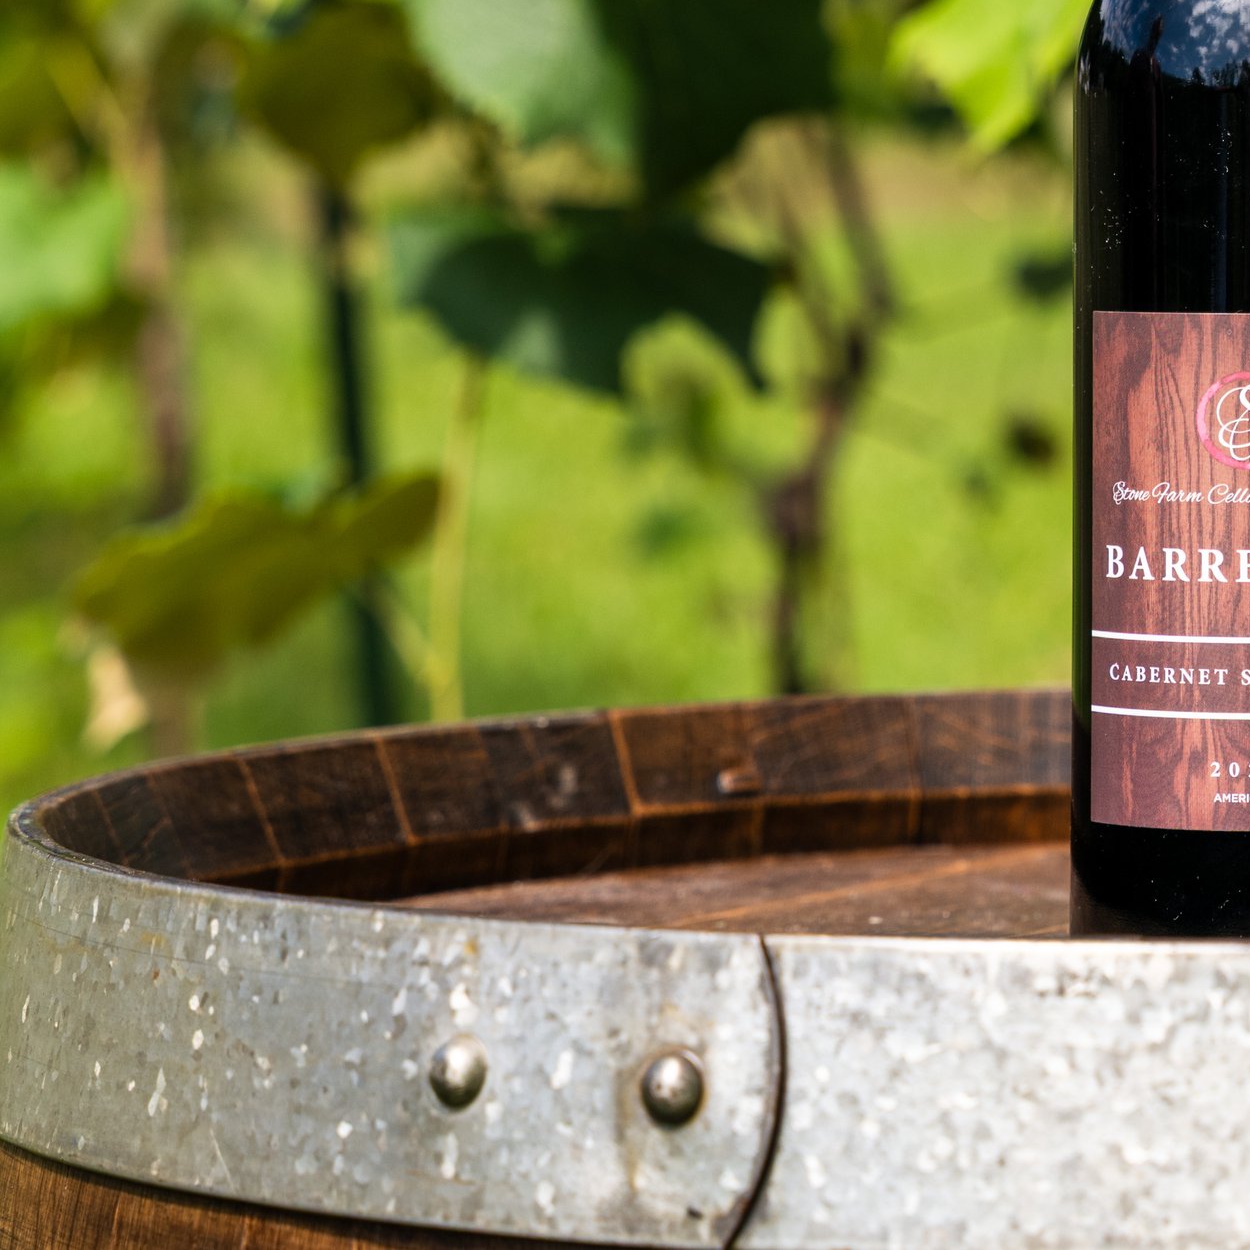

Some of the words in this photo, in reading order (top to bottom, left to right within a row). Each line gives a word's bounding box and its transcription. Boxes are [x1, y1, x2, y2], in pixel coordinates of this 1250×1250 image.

[1112, 480, 1150, 505] Stone
[1151, 481, 1203, 505] Farm
[1109, 662, 1228, 686] CABERNET
